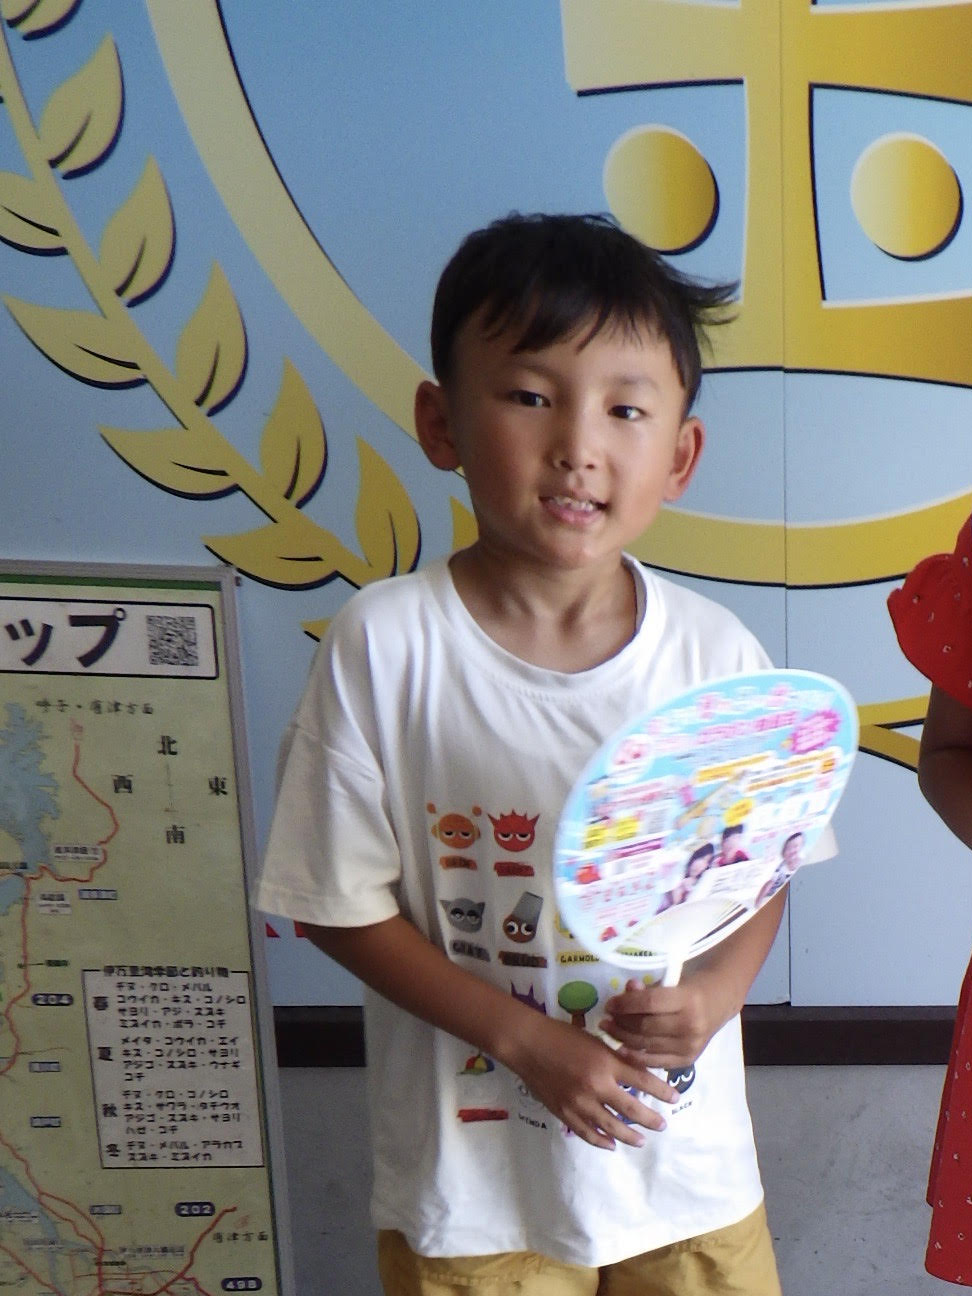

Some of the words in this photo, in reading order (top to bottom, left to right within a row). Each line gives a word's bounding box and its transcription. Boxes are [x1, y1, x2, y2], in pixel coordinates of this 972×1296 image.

[157, 735, 178, 756] 北
[112, 774, 134, 794] 西
[208, 776, 228, 796] 東
[166, 826, 185, 845] 南
